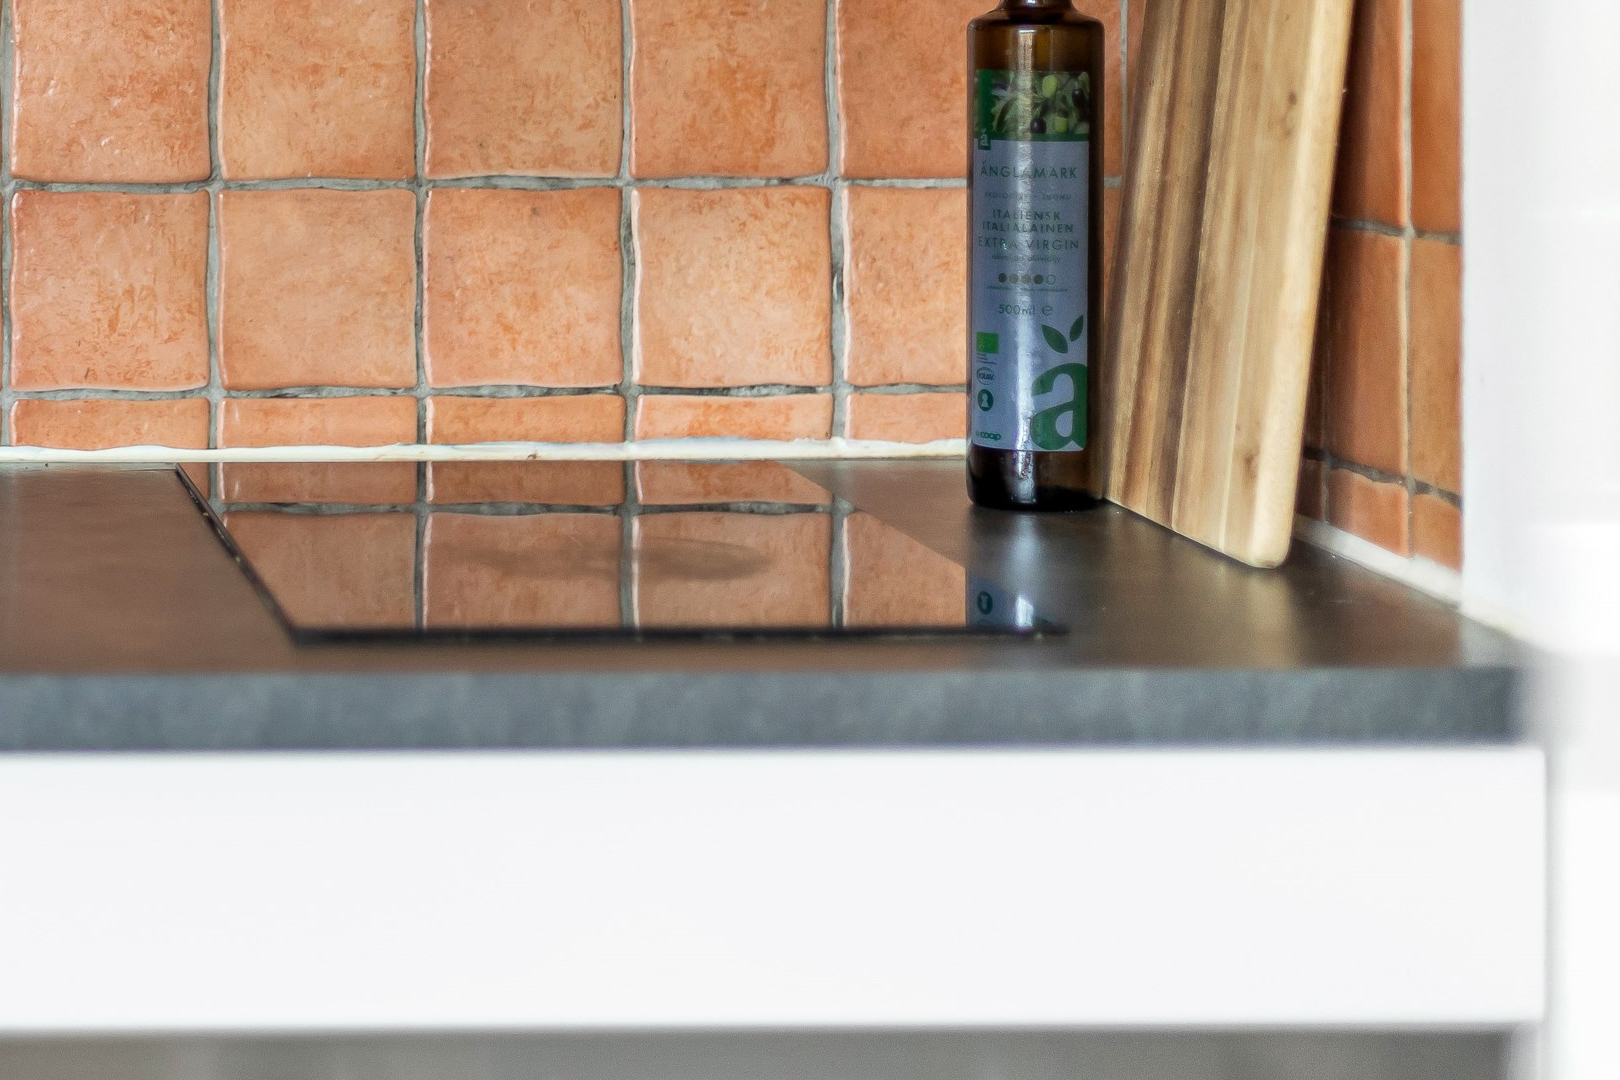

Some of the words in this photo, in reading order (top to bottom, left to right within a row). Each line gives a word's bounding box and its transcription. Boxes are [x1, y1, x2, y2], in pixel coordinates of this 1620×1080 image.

[993, 209, 1061, 221] ITALIENSK
[983, 221, 1074, 233] ITALIALAINEN
[978, 236, 1018, 249] EXTRA
[1026, 239, 1079, 251] VIRGIN
